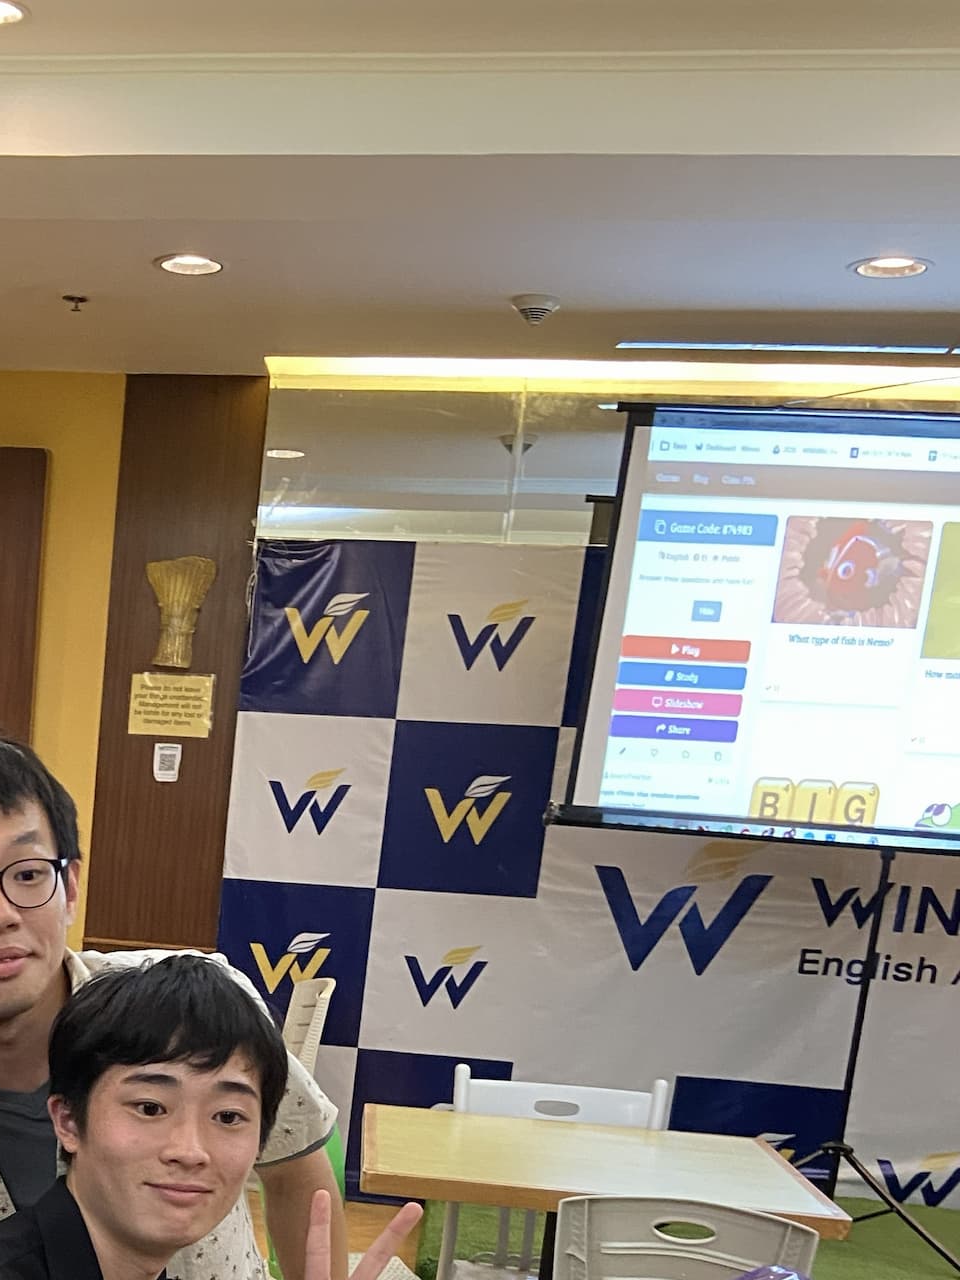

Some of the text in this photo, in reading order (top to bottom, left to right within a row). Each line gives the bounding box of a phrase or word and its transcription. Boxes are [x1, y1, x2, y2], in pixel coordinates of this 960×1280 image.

[670, 523, 696, 534] Game
[789, 634, 809, 644] What
[841, 637, 856, 646] fish
[676, 672, 699, 684] Study
[664, 698, 704, 709] Slideshow
[668, 725, 691, 735] Share
